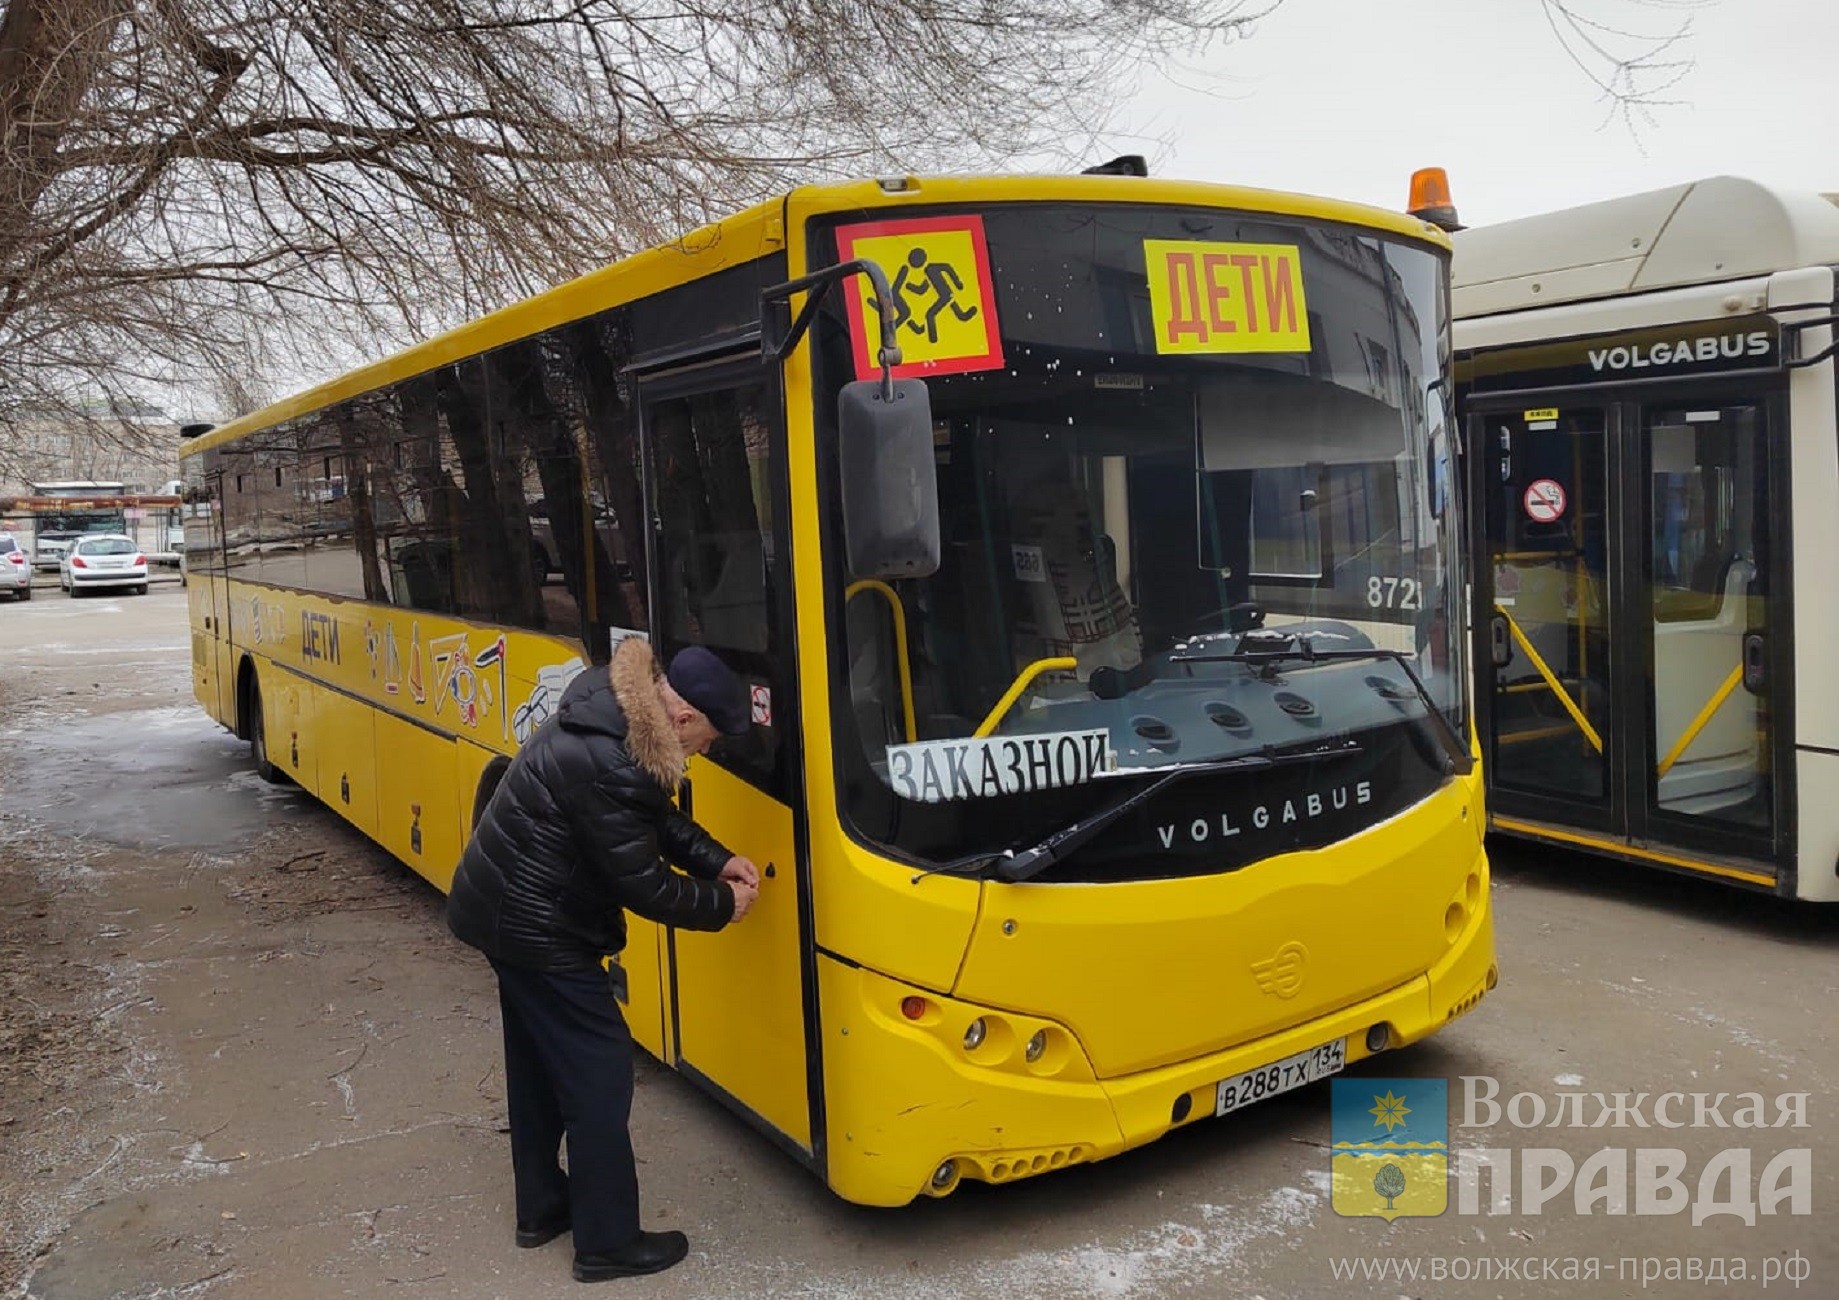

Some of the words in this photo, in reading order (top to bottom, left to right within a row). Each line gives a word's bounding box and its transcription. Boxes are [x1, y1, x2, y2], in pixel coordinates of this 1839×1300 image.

[1166, 253, 1297, 343] ДЕТИ
[1588, 331, 1769, 371] VOLGABUS
[303, 610, 340, 665] ДЕТИ
[1158, 781, 1370, 848] VOLGABUS
[1312, 1041, 1343, 1069] 134
